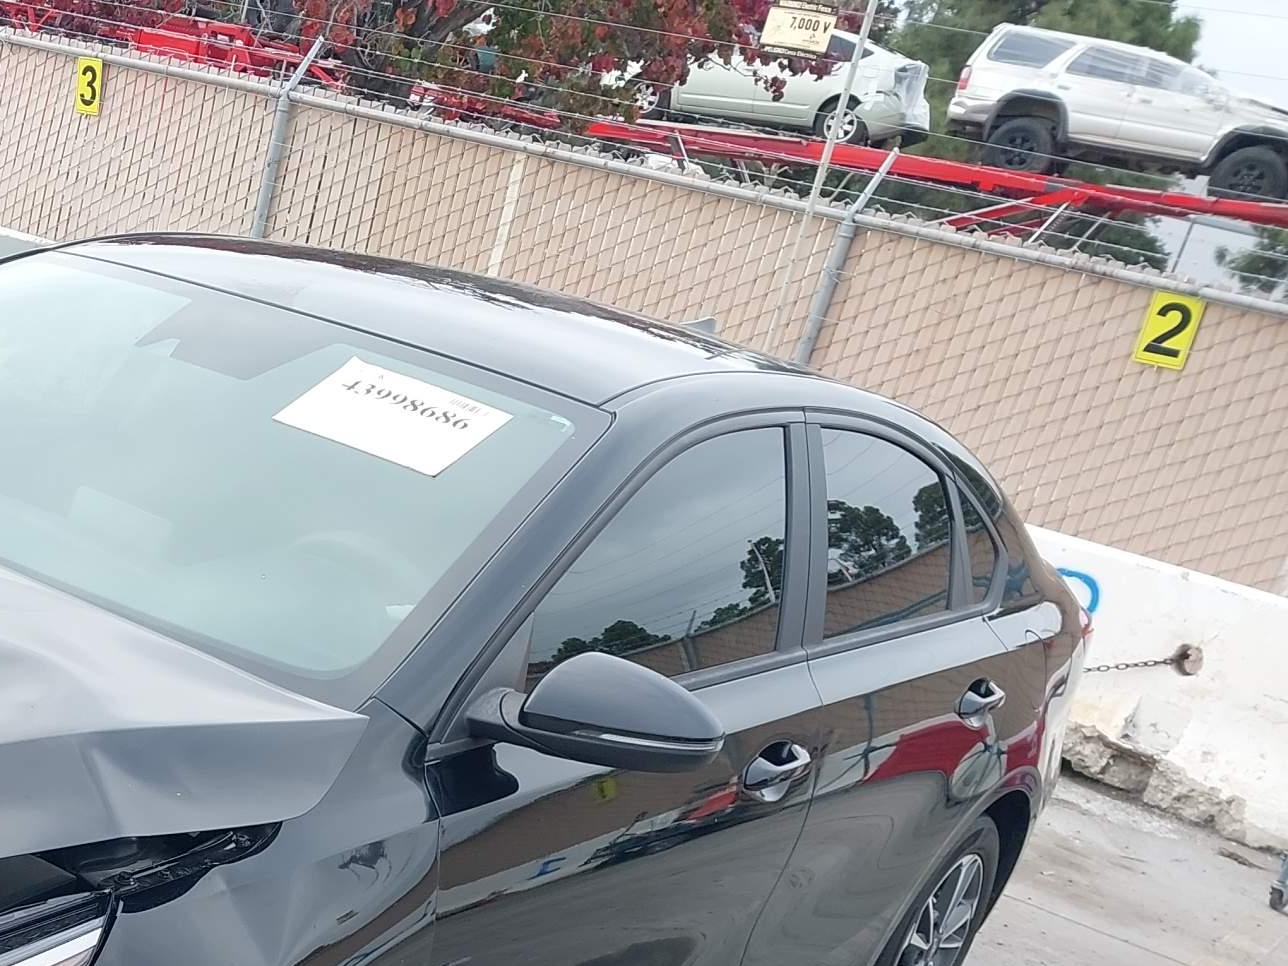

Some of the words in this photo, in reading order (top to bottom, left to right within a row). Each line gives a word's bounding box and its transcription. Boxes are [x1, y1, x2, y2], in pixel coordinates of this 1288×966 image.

[790, 16, 821, 32] 7,000
[823, 21, 832, 34] V
[79, 65, 97, 107] 3
[1142, 302, 1192, 359] 2
[341, 379, 469, 431] 43998686
